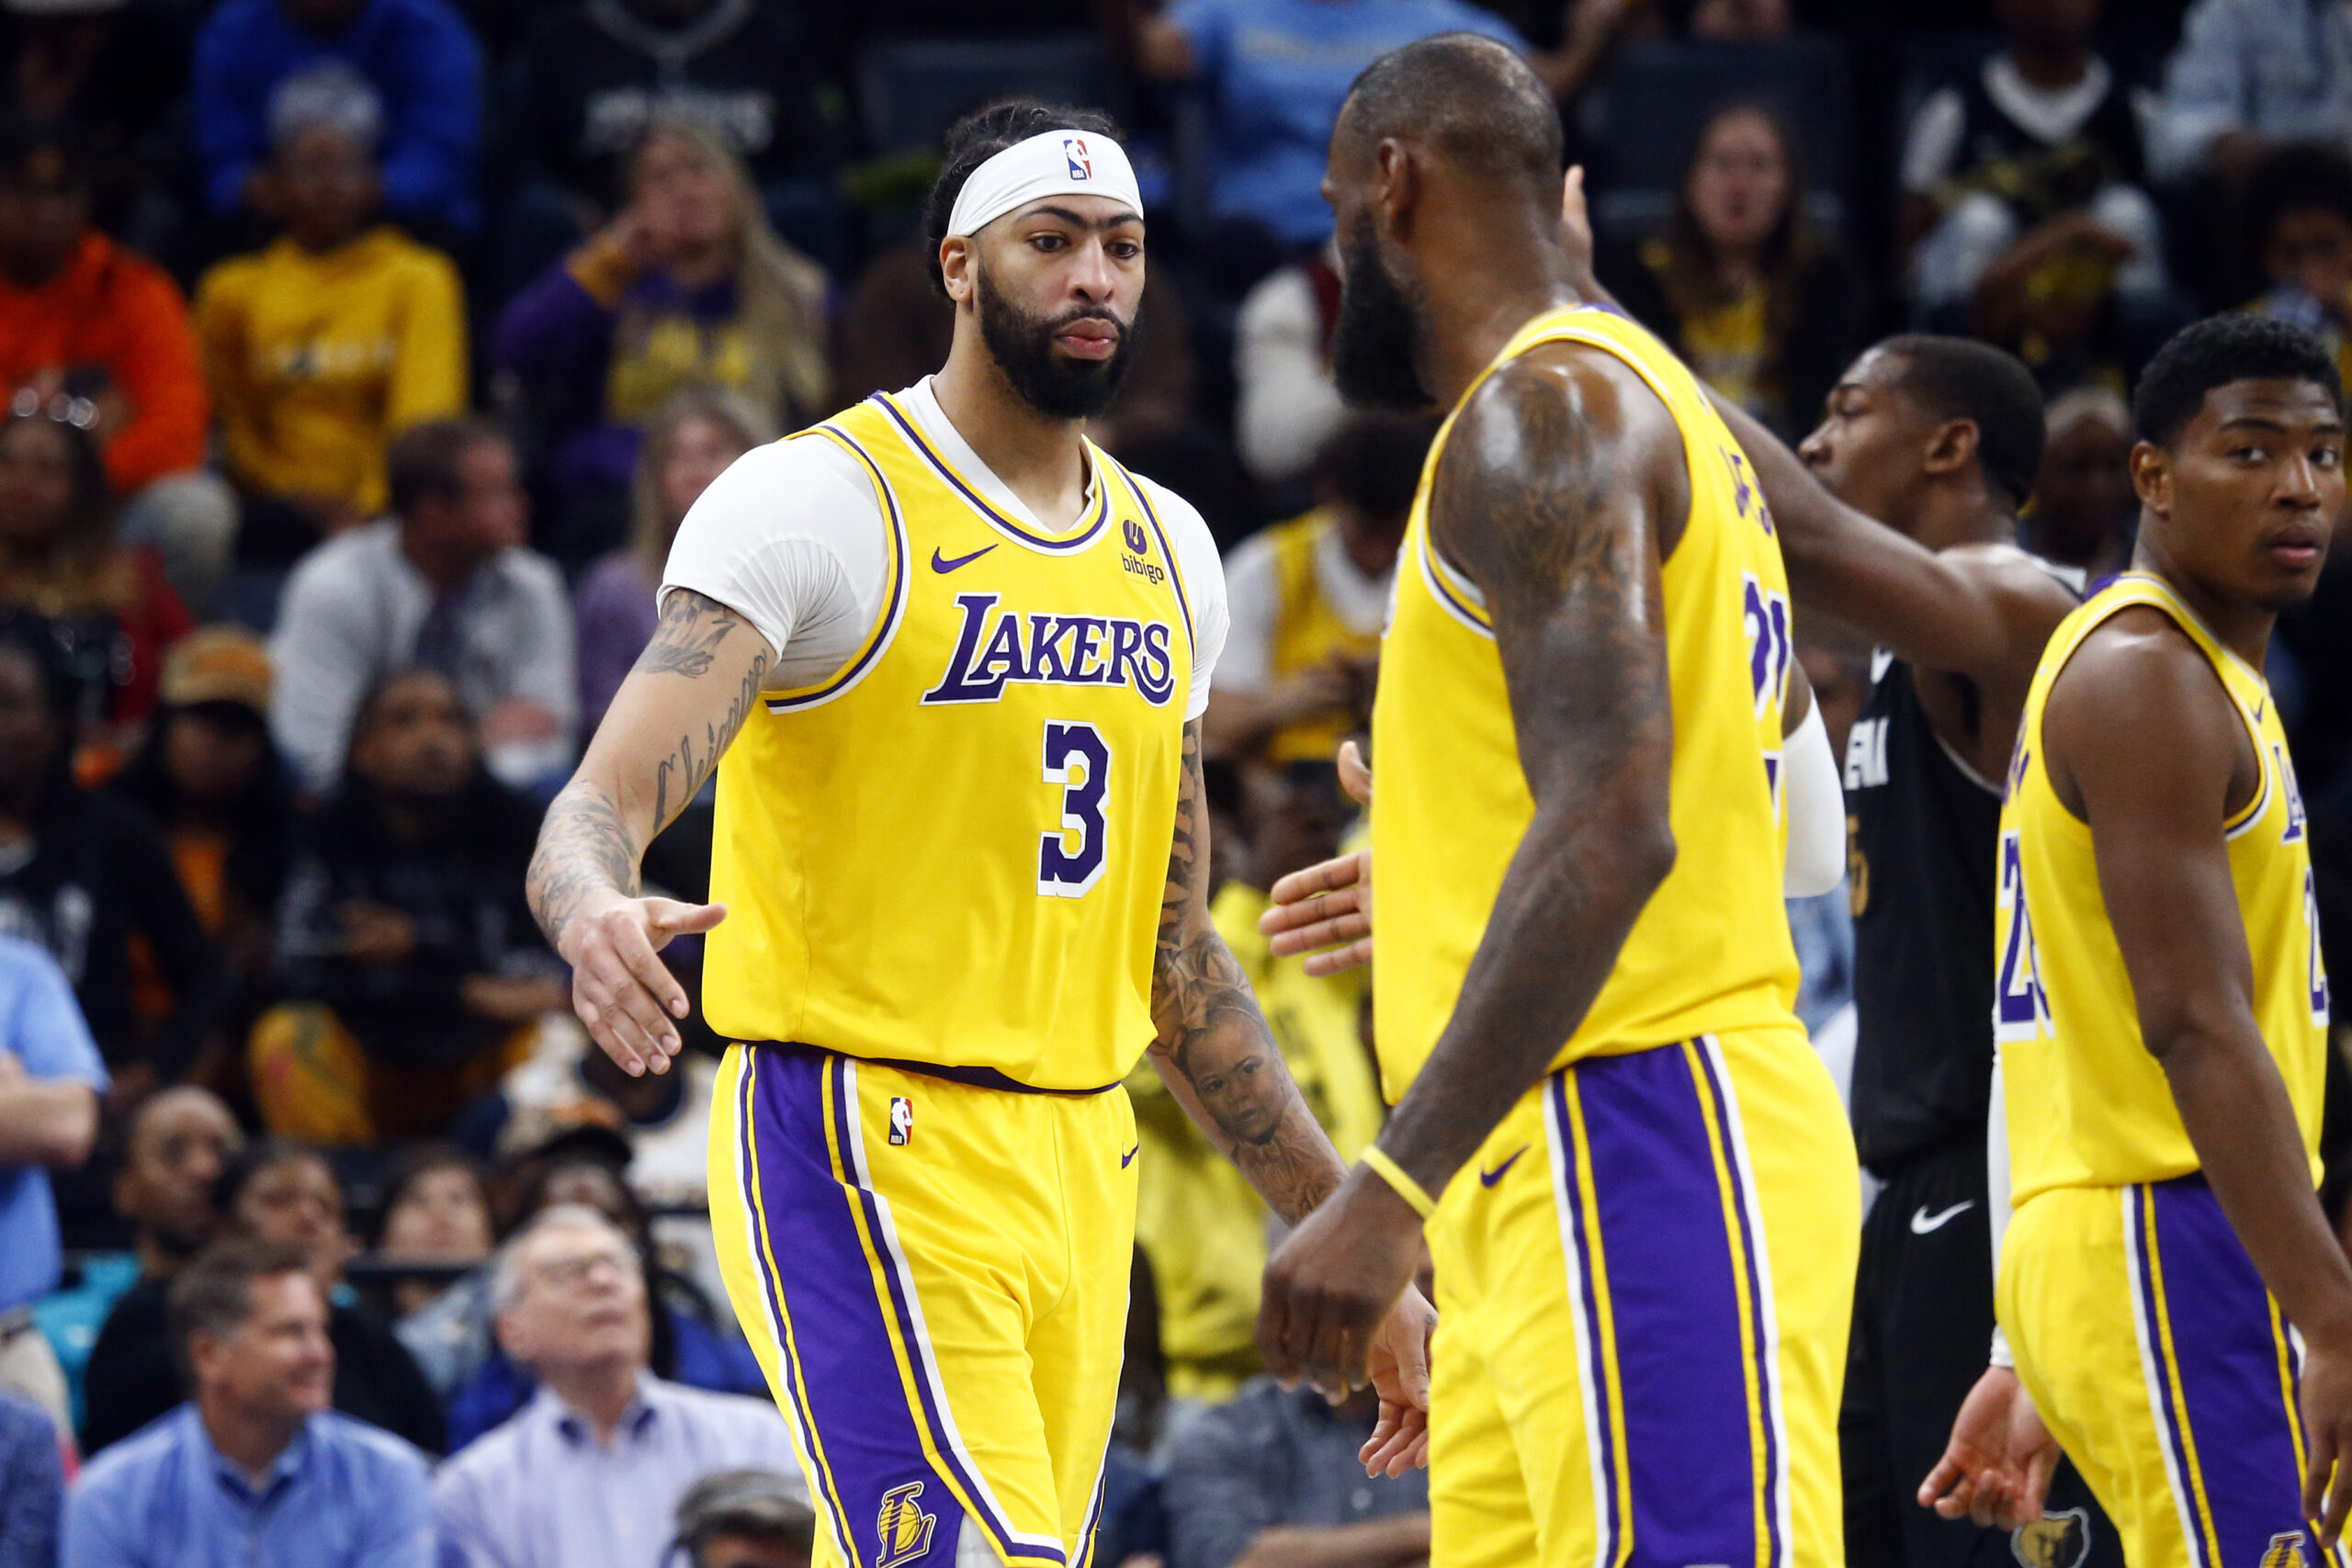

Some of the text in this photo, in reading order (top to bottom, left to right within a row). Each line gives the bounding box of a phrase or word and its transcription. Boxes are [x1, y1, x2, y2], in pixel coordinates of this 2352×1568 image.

[1121, 552, 1165, 585] bibigo
[919, 592, 1176, 708] LAKERS
[1036, 718, 1113, 898] 3
